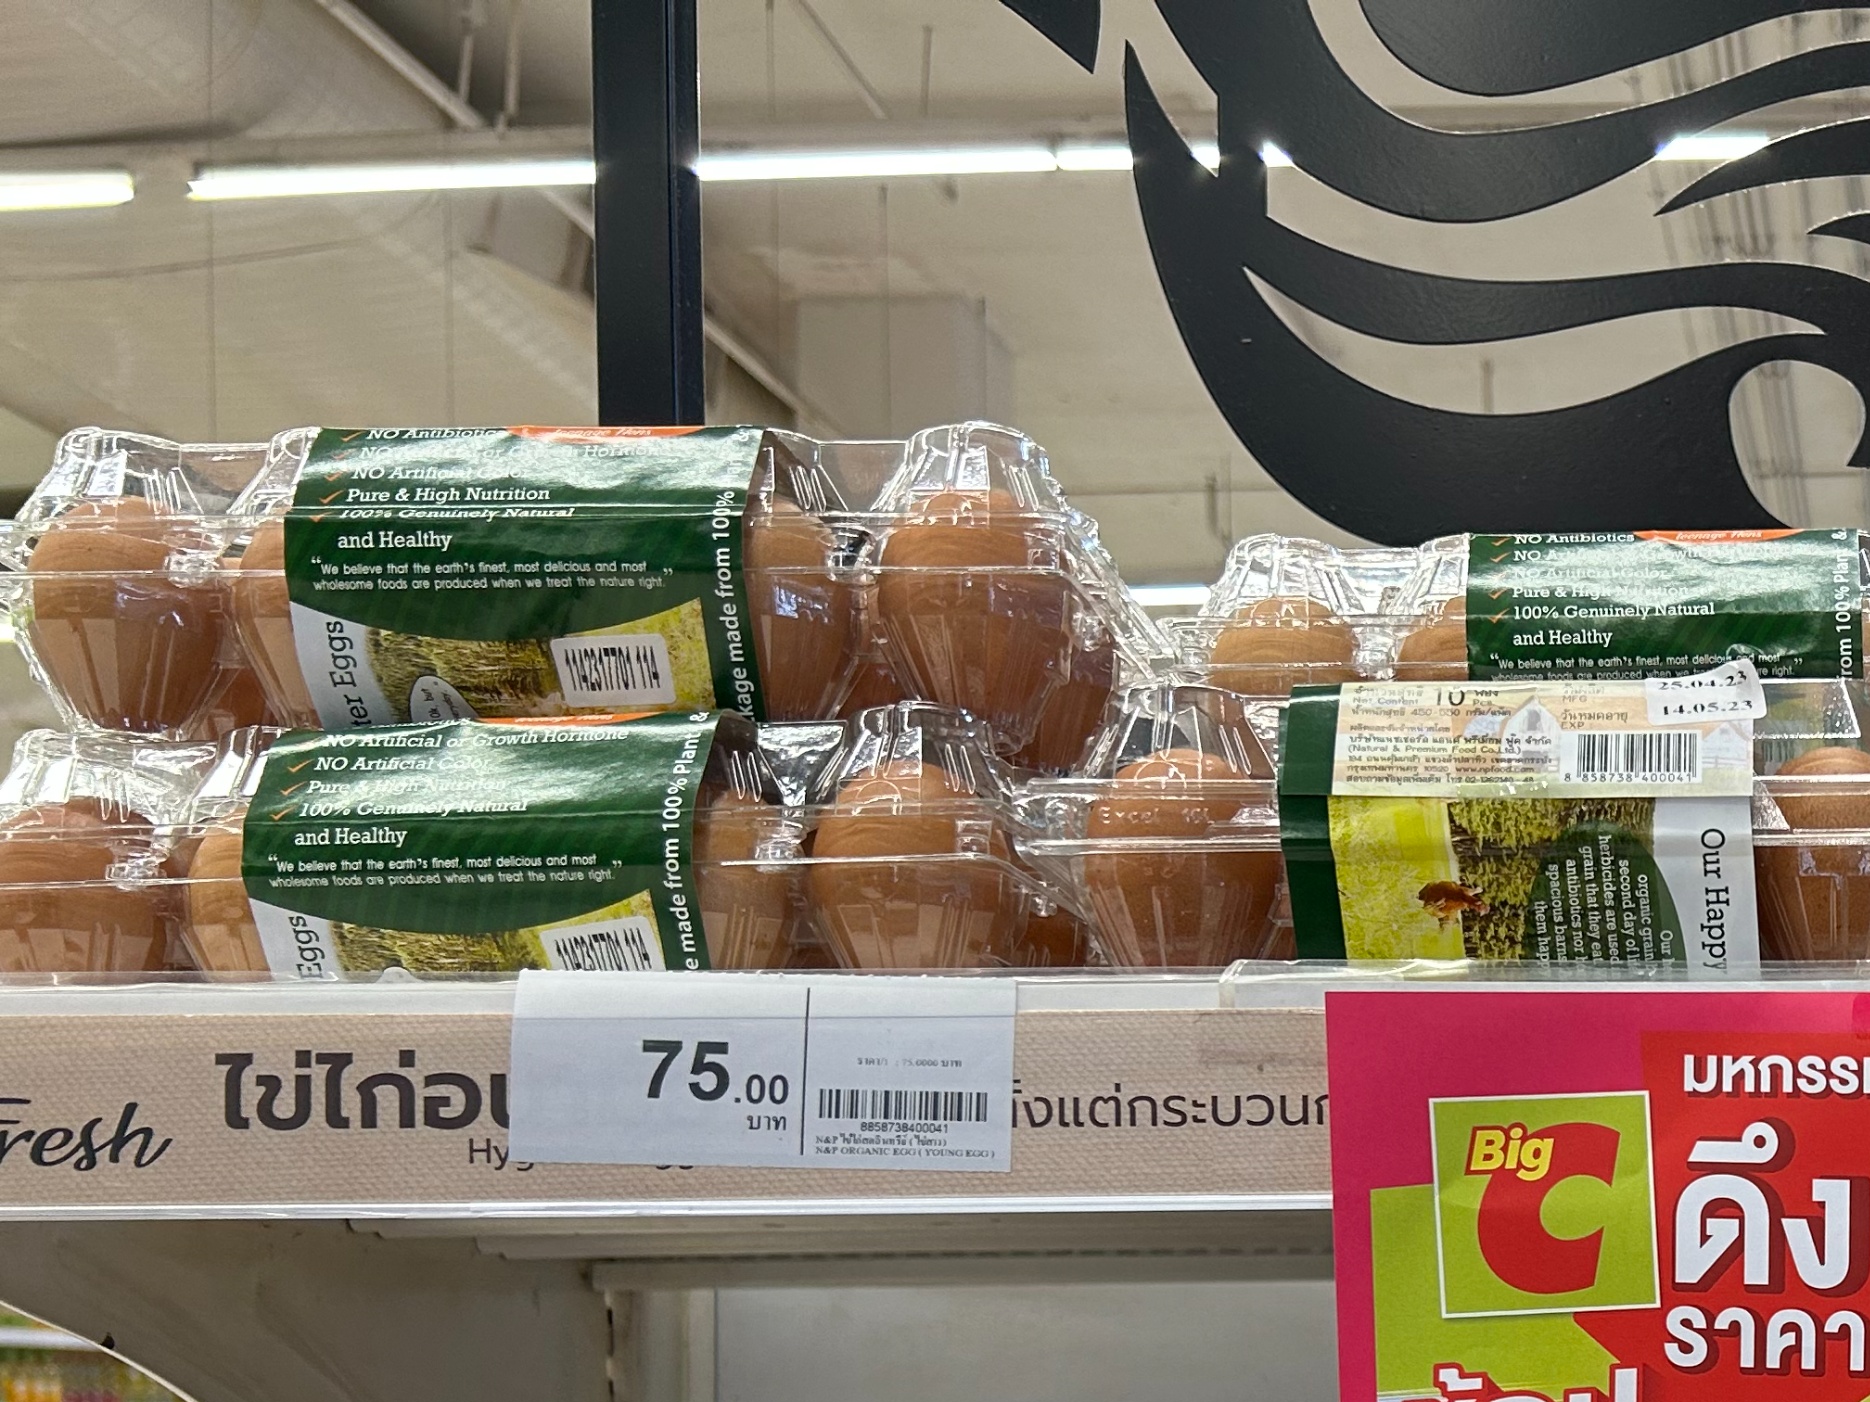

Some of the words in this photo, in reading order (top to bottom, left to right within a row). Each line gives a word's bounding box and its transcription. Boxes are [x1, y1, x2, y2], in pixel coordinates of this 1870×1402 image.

[338, 534, 373, 548] and
[378, 533, 452, 551] Healthy
[1514, 605, 1559, 619] 100%
[1564, 605, 1649, 620] Genuinely
[1654, 603, 1714, 616] Natural
[326, 621, 357, 687] Eggs
[1662, 700, 1753, 715] 14.05.23
[676, 732, 699, 777] Plant
[1564, 773, 1571, 782] 8
[1582, 773, 1633, 782] 858738
[1641, 773, 1693, 782] 400041
[662, 780, 684, 831] 100%
[664, 838, 682, 889] from
[1599, 835, 1616, 907] herbicides
[1701, 829, 1725, 878] Our
[1546, 864, 1564, 922] spacious
[1566, 859, 1583, 928] antibiotics
[673, 893, 696, 953] made
[1605, 910, 1616, 931] are
[643, 1040, 730, 1101] 75
[734, 1075, 789, 1104] .00
[0, 1098, 173, 1171] resh
[747, 1114, 787, 1130] บาท
[860, 1122, 948, 1133] 8858738400041
[841, 1147, 890, 1156] ORGANIC
[893, 1147, 916, 1156] EGG
[926, 1148, 962, 1157] YOUNG
[1472, 1129, 1554, 1179] Big
[1478, 1122, 1618, 1294] C
[1674, 1121, 1852, 1289] ดึง
[1665, 1308, 1866, 1372] ราคา
